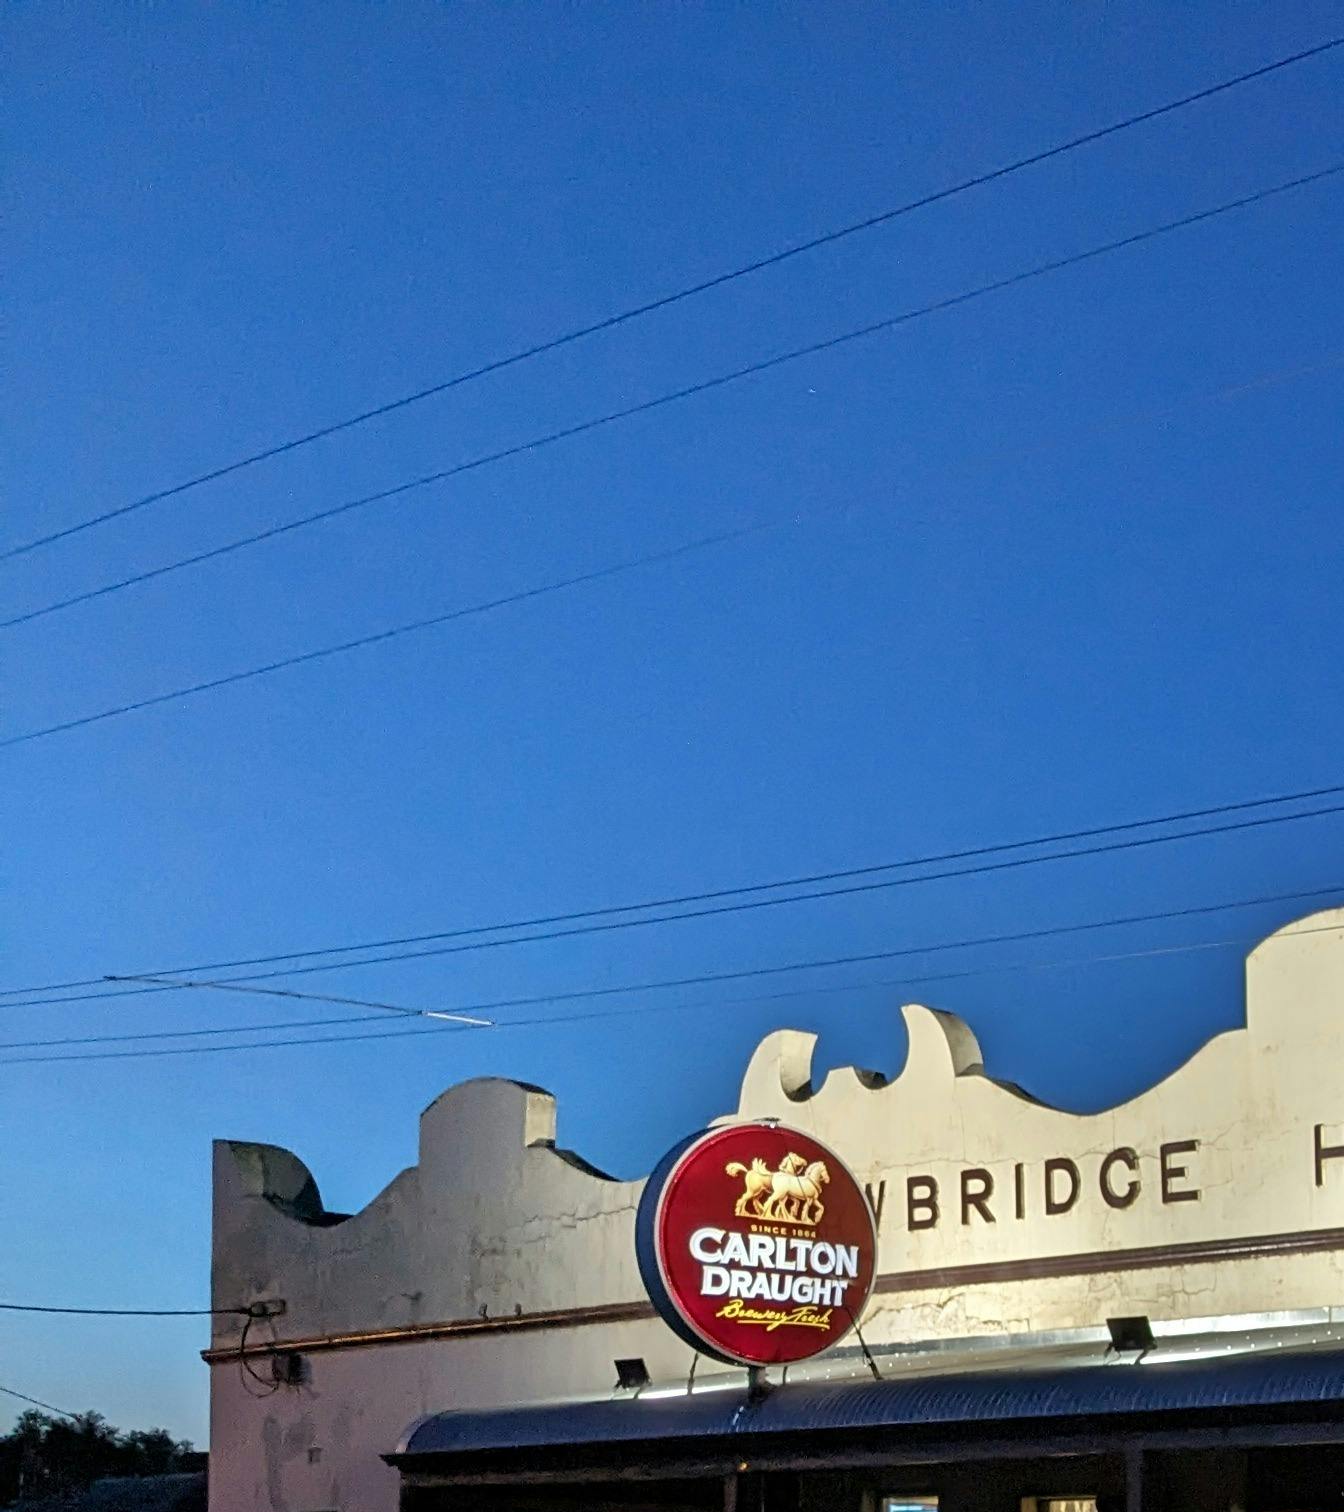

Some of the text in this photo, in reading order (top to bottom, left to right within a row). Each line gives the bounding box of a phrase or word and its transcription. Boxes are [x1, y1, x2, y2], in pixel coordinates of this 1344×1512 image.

[865, 1138, 1202, 1232] BRIDGE
[750, 1223, 787, 1236] SINCE
[688, 1226, 859, 1279] CARLTON
[699, 1265, 849, 1307] DRAUGHT
[715, 1299, 834, 1332] Brewery Fresh
